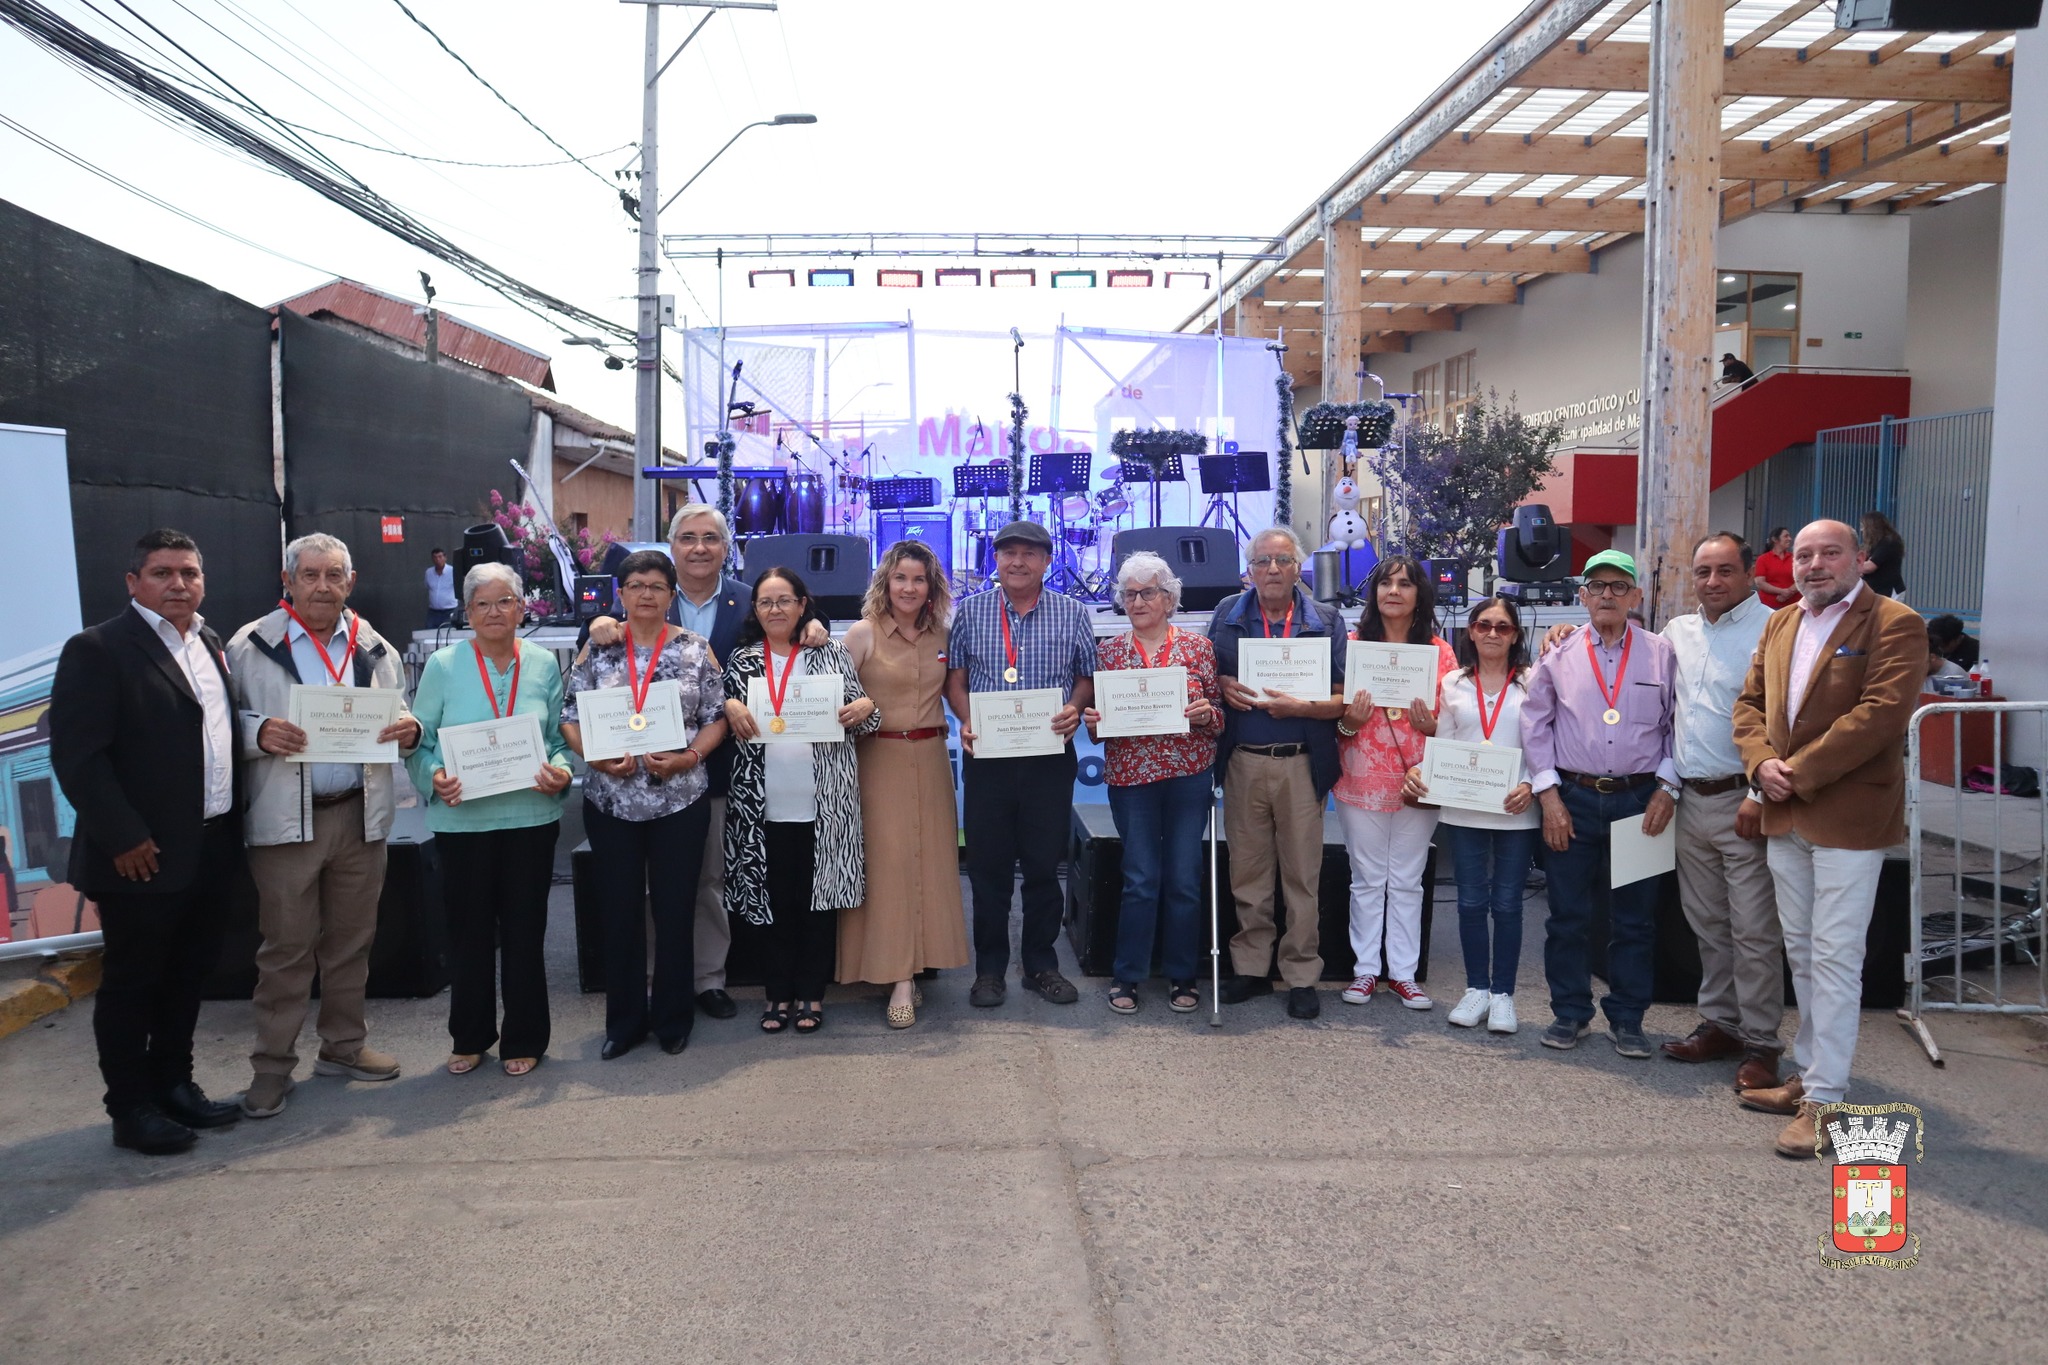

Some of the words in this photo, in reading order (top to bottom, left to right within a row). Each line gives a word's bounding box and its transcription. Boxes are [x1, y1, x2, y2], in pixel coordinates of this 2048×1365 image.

[1121, 383, 1144, 400] de
[1522, 410, 1552, 428] EDIFICIO
[1554, 402, 1587, 421] CENTRO
[1587, 394, 1618, 415] CÍVICO
[1619, 396, 1625, 412] y
[1614, 416, 1625, 431] de
[1362, 663, 1390, 671] DIPLOMA
[1112, 692, 1141, 700] DIPLOMA
[310, 711, 344, 720] DIPLOMA
[598, 711, 629, 719] DIPLOMA
[987, 713, 1016, 721] DIPLOMA
[462, 746, 493, 756] DIPLOMA
[493, 744, 501, 752] DE
[502, 739, 528, 750] HONOR
[1440, 762, 1470, 770] DIPLOMA
[1480, 766, 1505, 775] HONOR
[1450, 775, 1467, 783] Teresa
[1485, 780, 1507, 788] Delgado
